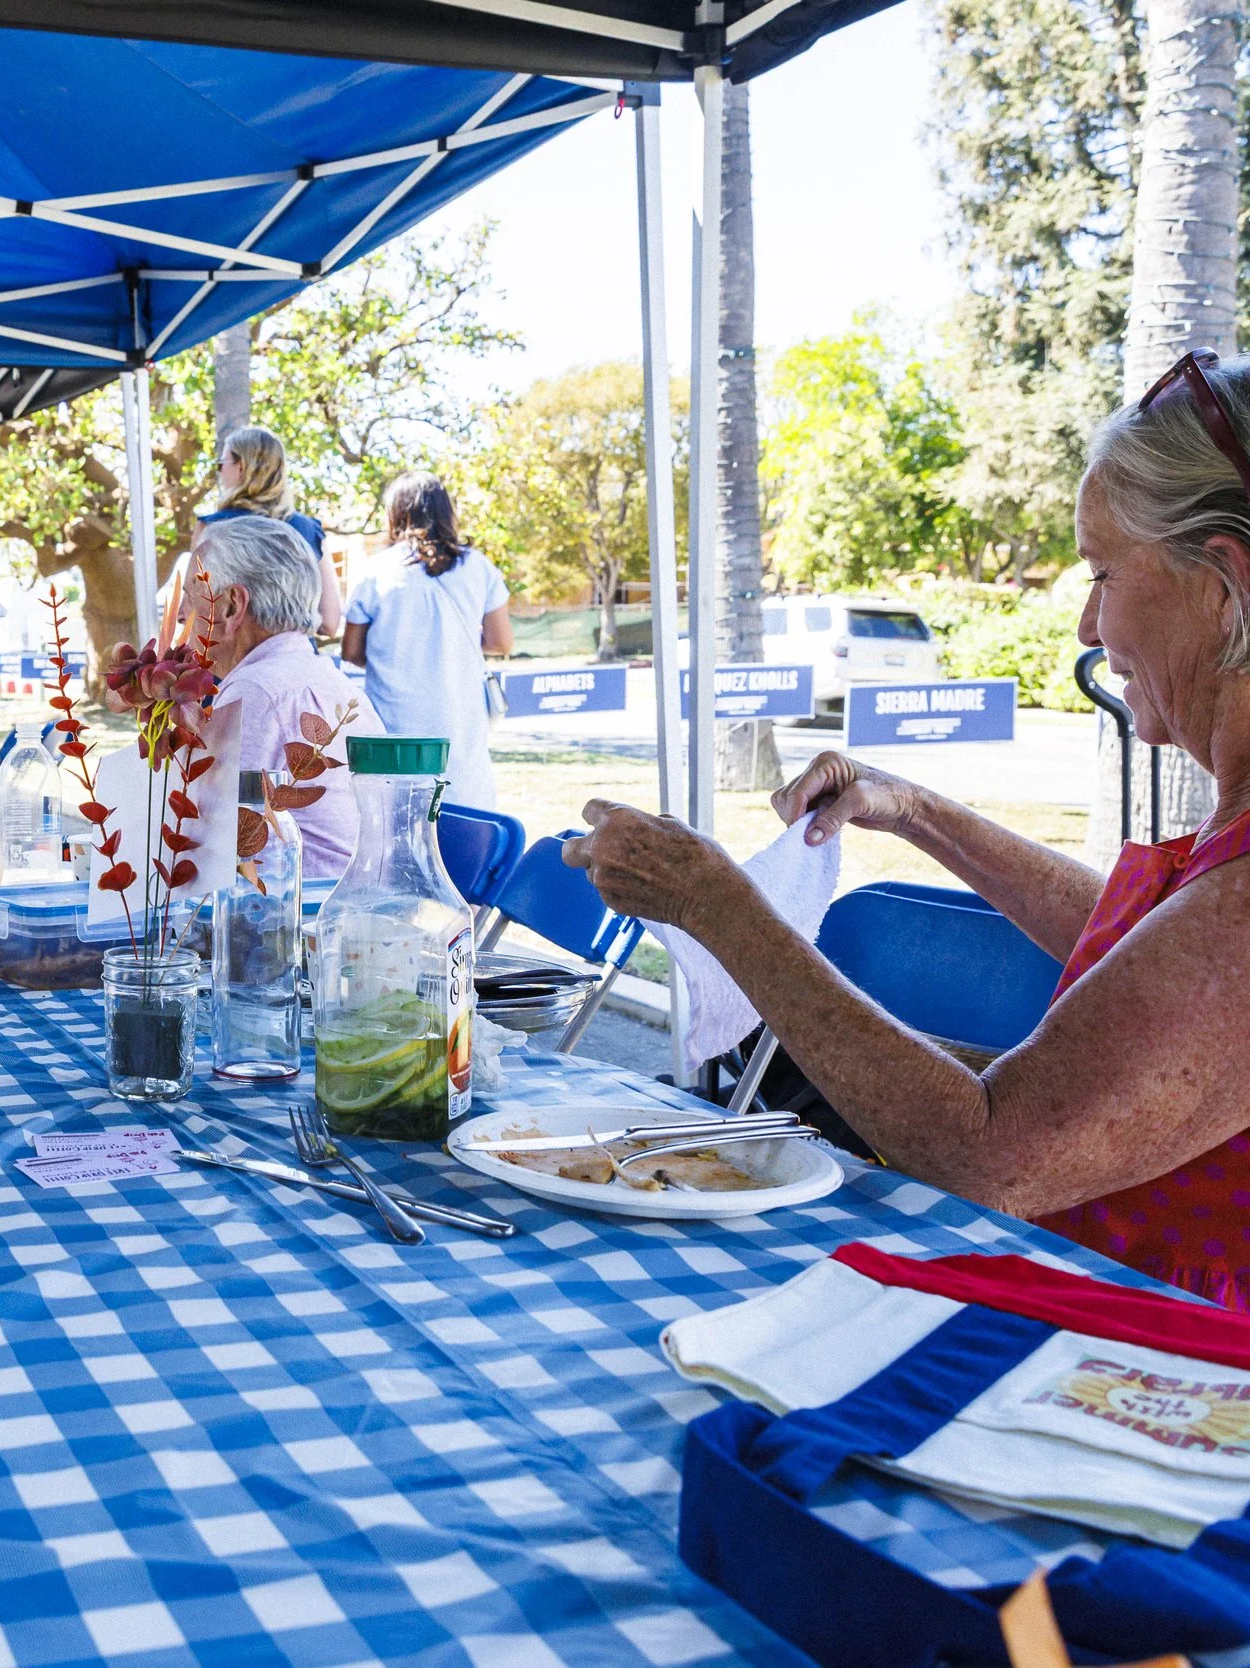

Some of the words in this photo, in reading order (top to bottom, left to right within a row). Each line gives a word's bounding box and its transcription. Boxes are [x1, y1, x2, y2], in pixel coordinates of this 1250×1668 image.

[749, 670, 798, 691] KNOLLS
[875, 690, 929, 715] SIERRA
[930, 688, 986, 712] MADRE
